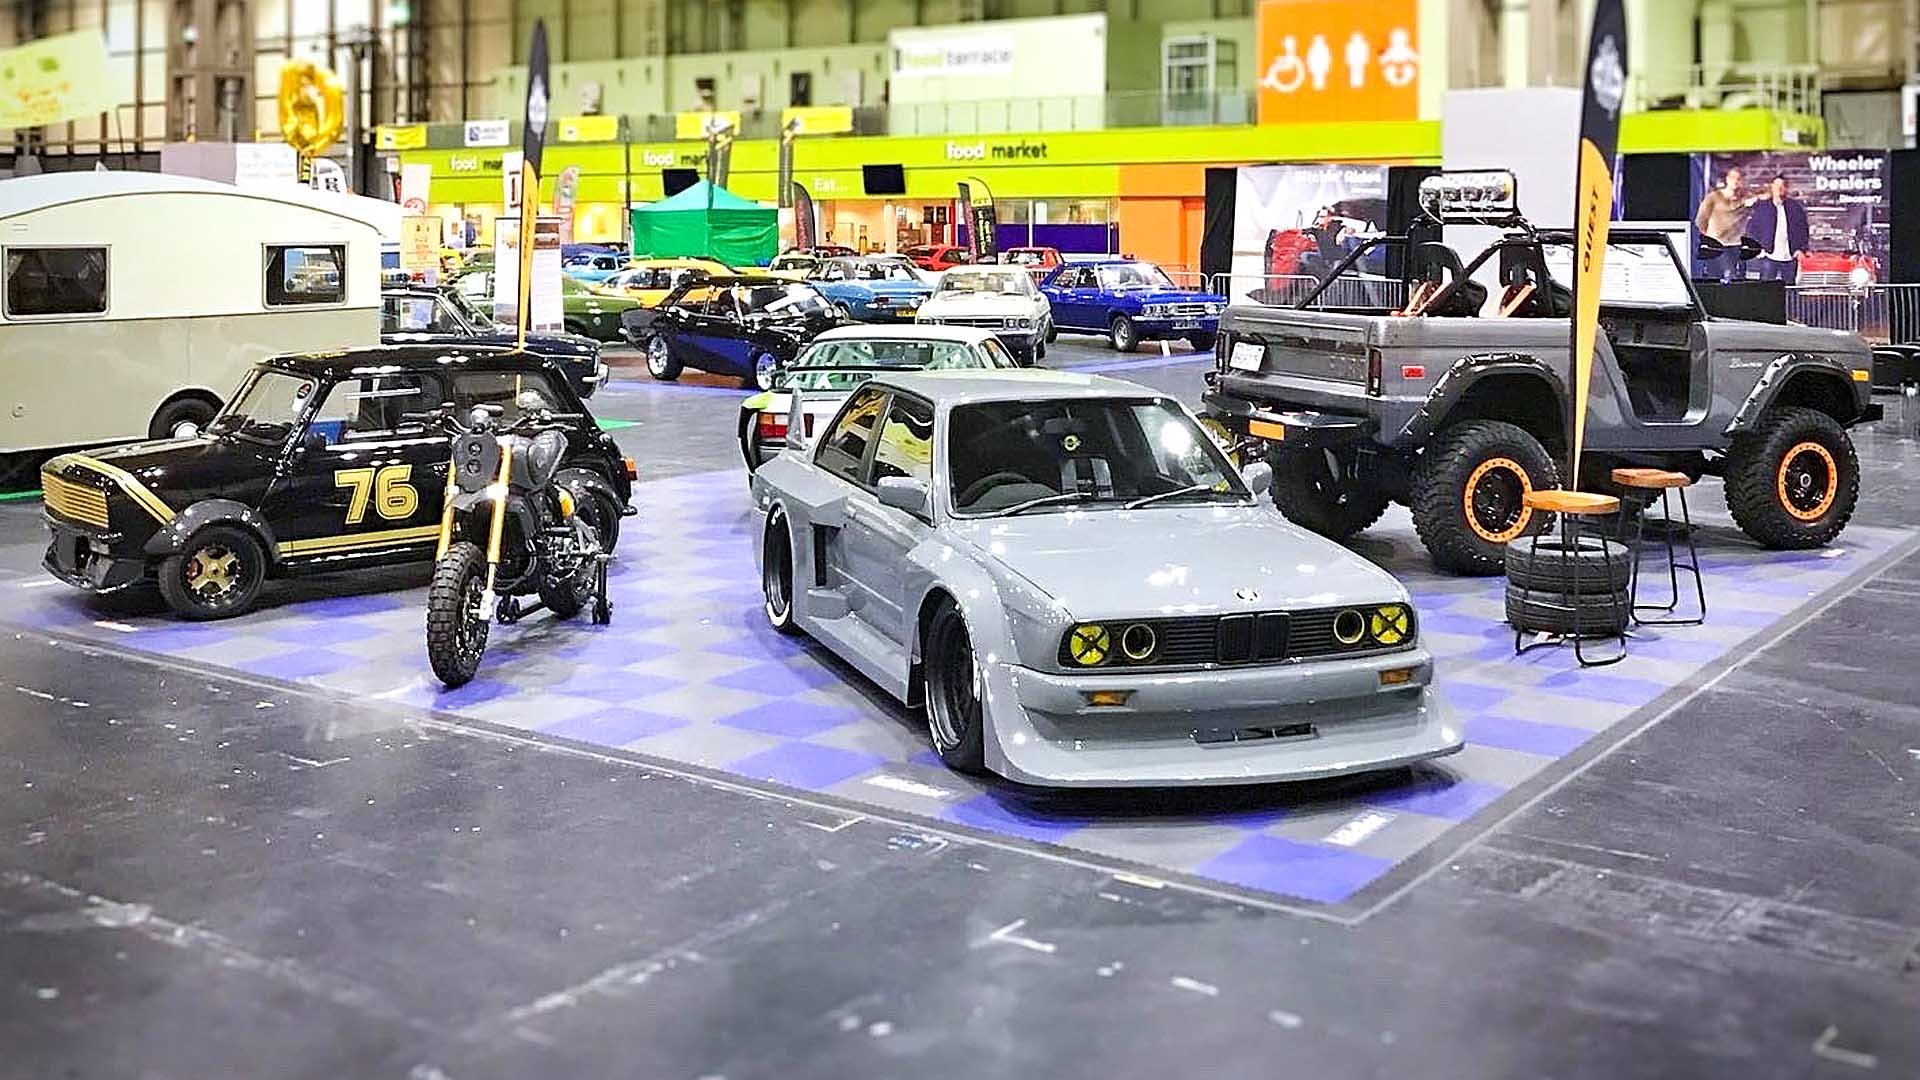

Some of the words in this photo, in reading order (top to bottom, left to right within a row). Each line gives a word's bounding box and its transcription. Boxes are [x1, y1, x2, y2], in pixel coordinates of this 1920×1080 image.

[947, 141, 985, 159] food
[992, 140, 1047, 158] market
[451, 154, 478, 170] food
[643, 151, 674, 166] food
[1808, 155, 1882, 171] Wheeler
[1815, 174, 1882, 190] Dealers
[1583, 184, 1599, 272] QUEST
[334, 464, 419, 524] 76
